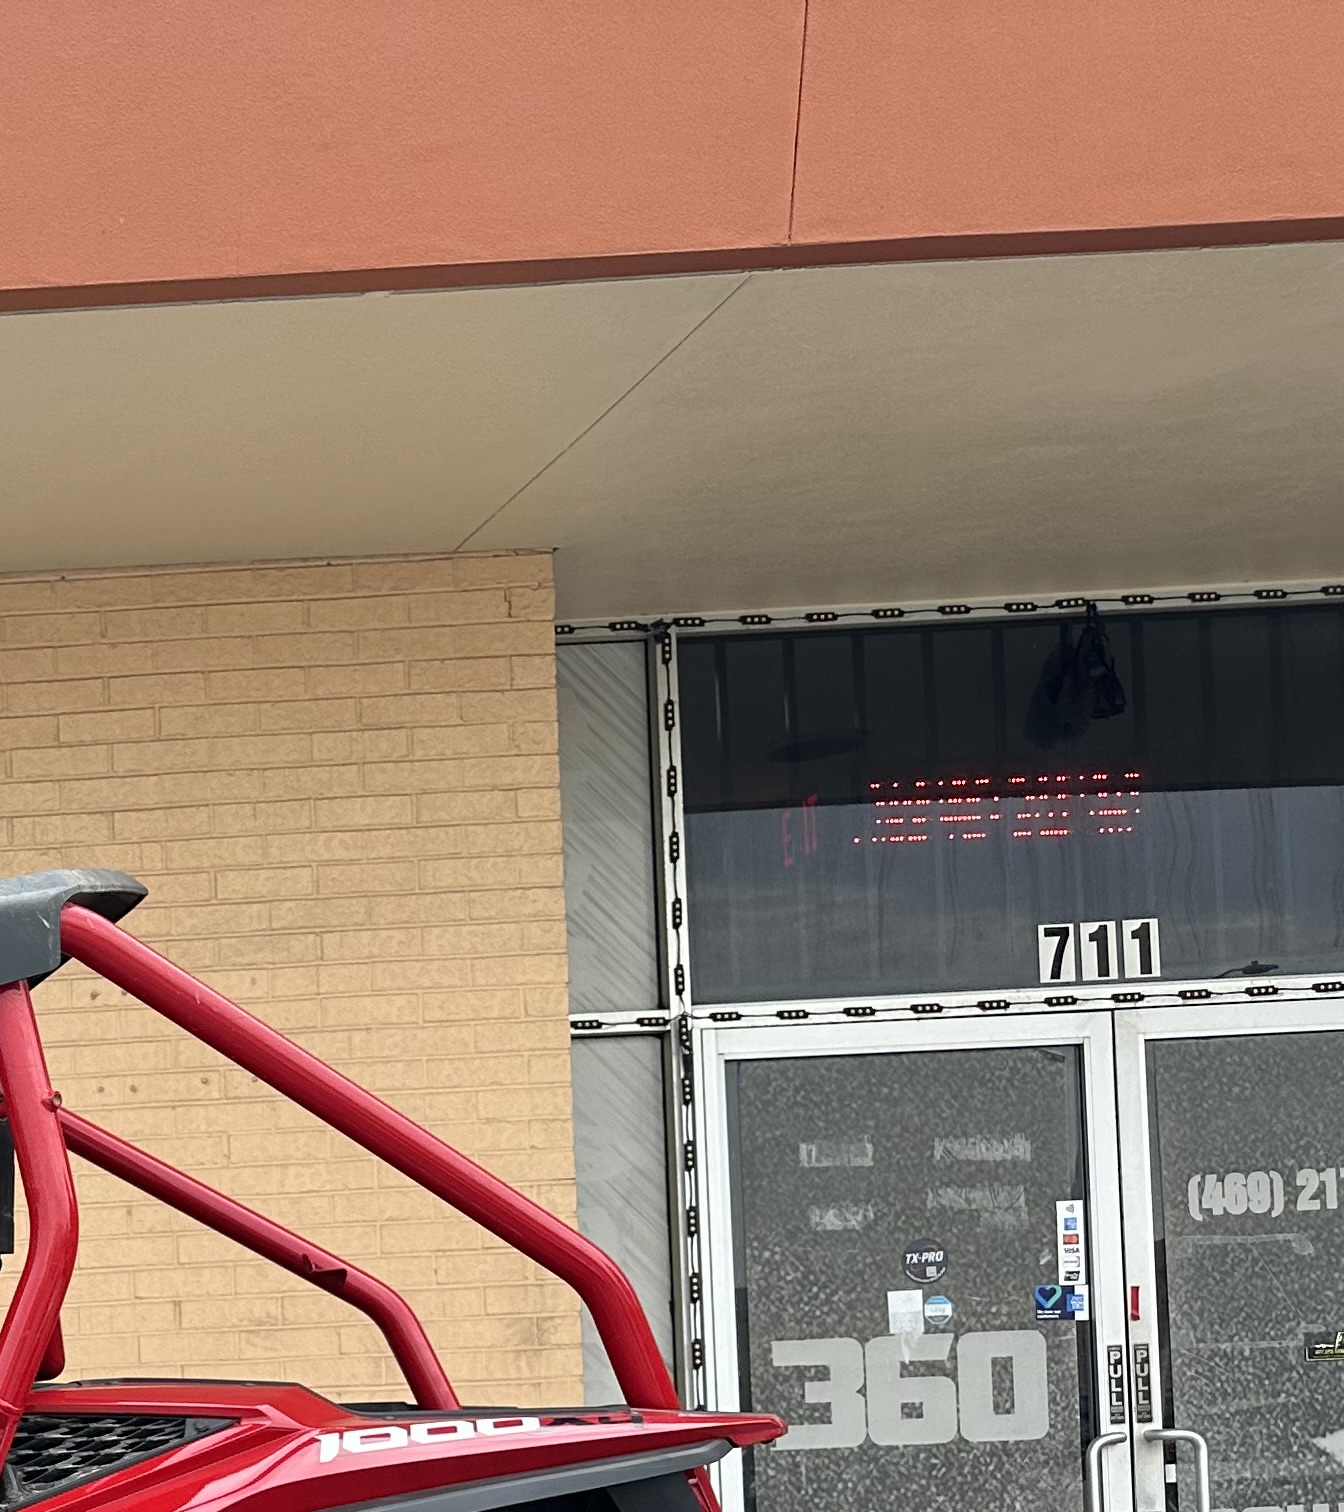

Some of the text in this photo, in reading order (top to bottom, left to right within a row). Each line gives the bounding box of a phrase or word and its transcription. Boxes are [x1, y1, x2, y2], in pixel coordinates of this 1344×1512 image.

[1042, 920, 1155, 980] 711
[1187, 1167, 1344, 1222] (469) 21
[905, 1250, 944, 1265] TX-PRO
[771, 1329, 1049, 1453] 360
[1109, 1350, 1123, 1406] PULL
[1135, 1349, 1150, 1404] PULL
[316, 1416, 541, 1464] 1000
